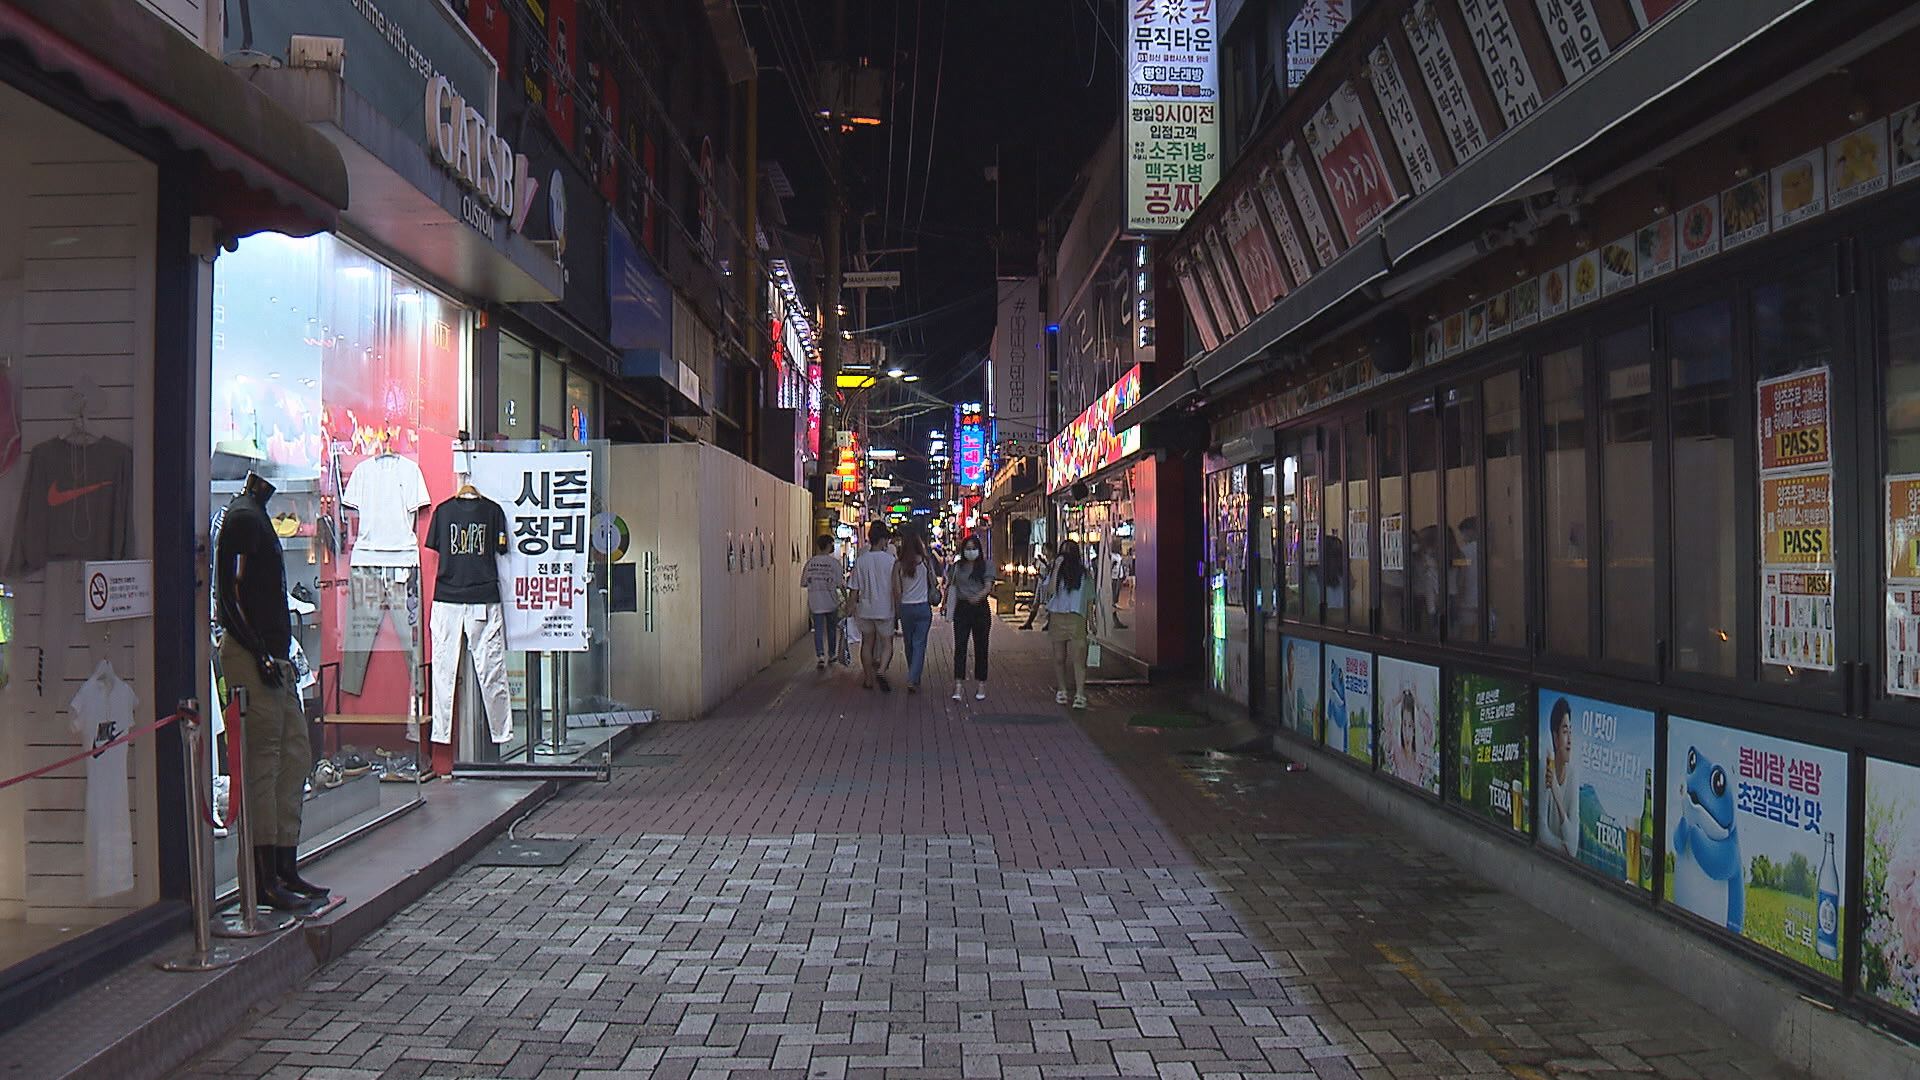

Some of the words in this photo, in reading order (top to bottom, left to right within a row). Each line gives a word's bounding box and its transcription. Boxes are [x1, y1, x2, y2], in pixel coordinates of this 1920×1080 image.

[385, 19, 407, 57] with
[409, 44, 433, 80] great
[1135, 27, 1213, 52] 뮤직타운
[1485, 0, 1538, 114] 국3
[1143, 66, 1166, 81] 평일
[1169, 66, 1203, 81] 노래방
[1150, 125, 1197, 140] 입점고객
[1149, 141, 1206, 161] 소주1병
[1145, 163, 1202, 183] 맥주1병
[1145, 182, 1202, 215] 공짜
[462, 196, 496, 240] CUSTOM
[1781, 429, 1820, 457] PASS
[515, 469, 588, 510] 시즌
[514, 515, 584, 556] 정리
[1783, 529, 1823, 554] PASS
[515, 577, 584, 610] 만원부터~
[1807, 576, 1826, 593] PASS
[1504, 742, 1520, 761] 100%
[1739, 745, 1785, 786] 봄바람
[1788, 759, 1822, 796] 살랑
[1488, 783, 1512, 816] TERRA
[1738, 782, 1801, 828] 초깔끔한
[1804, 799, 1822, 834] 맛
[1596, 821, 1624, 853] TERRA
